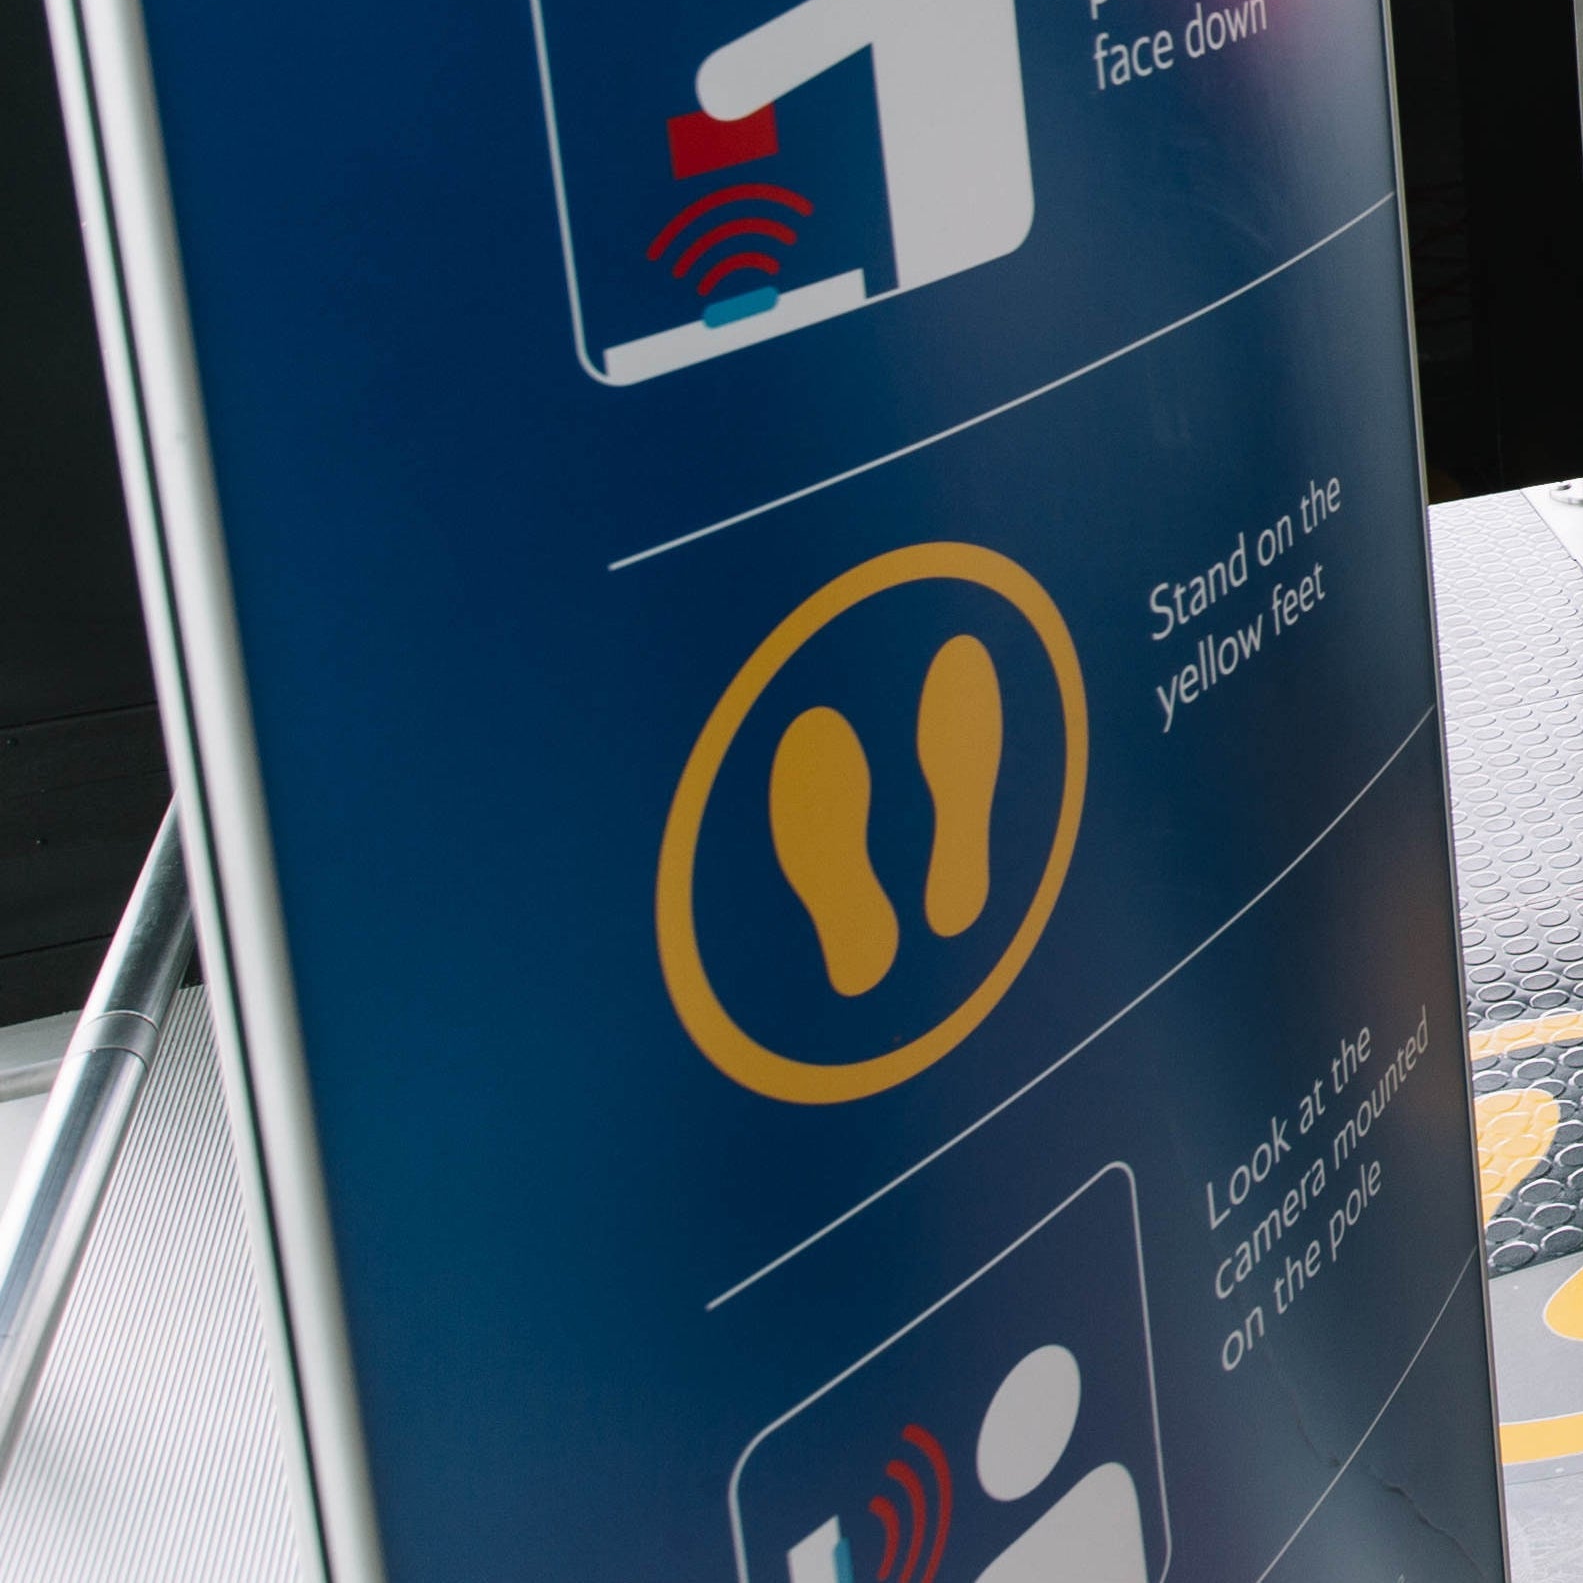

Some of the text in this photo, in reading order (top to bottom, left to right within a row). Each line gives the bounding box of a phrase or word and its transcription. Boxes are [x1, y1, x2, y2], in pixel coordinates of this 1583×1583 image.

[1093, 30, 1174, 90] face
[1150, 477, 1341, 641] Stand on the
[1156, 562, 1326, 733] yellow feet
[1206, 1025, 1371, 1230] Look at the
[1214, 1004, 1430, 1300] camera mounted
[1221, 1159, 1382, 1372] on the pole
